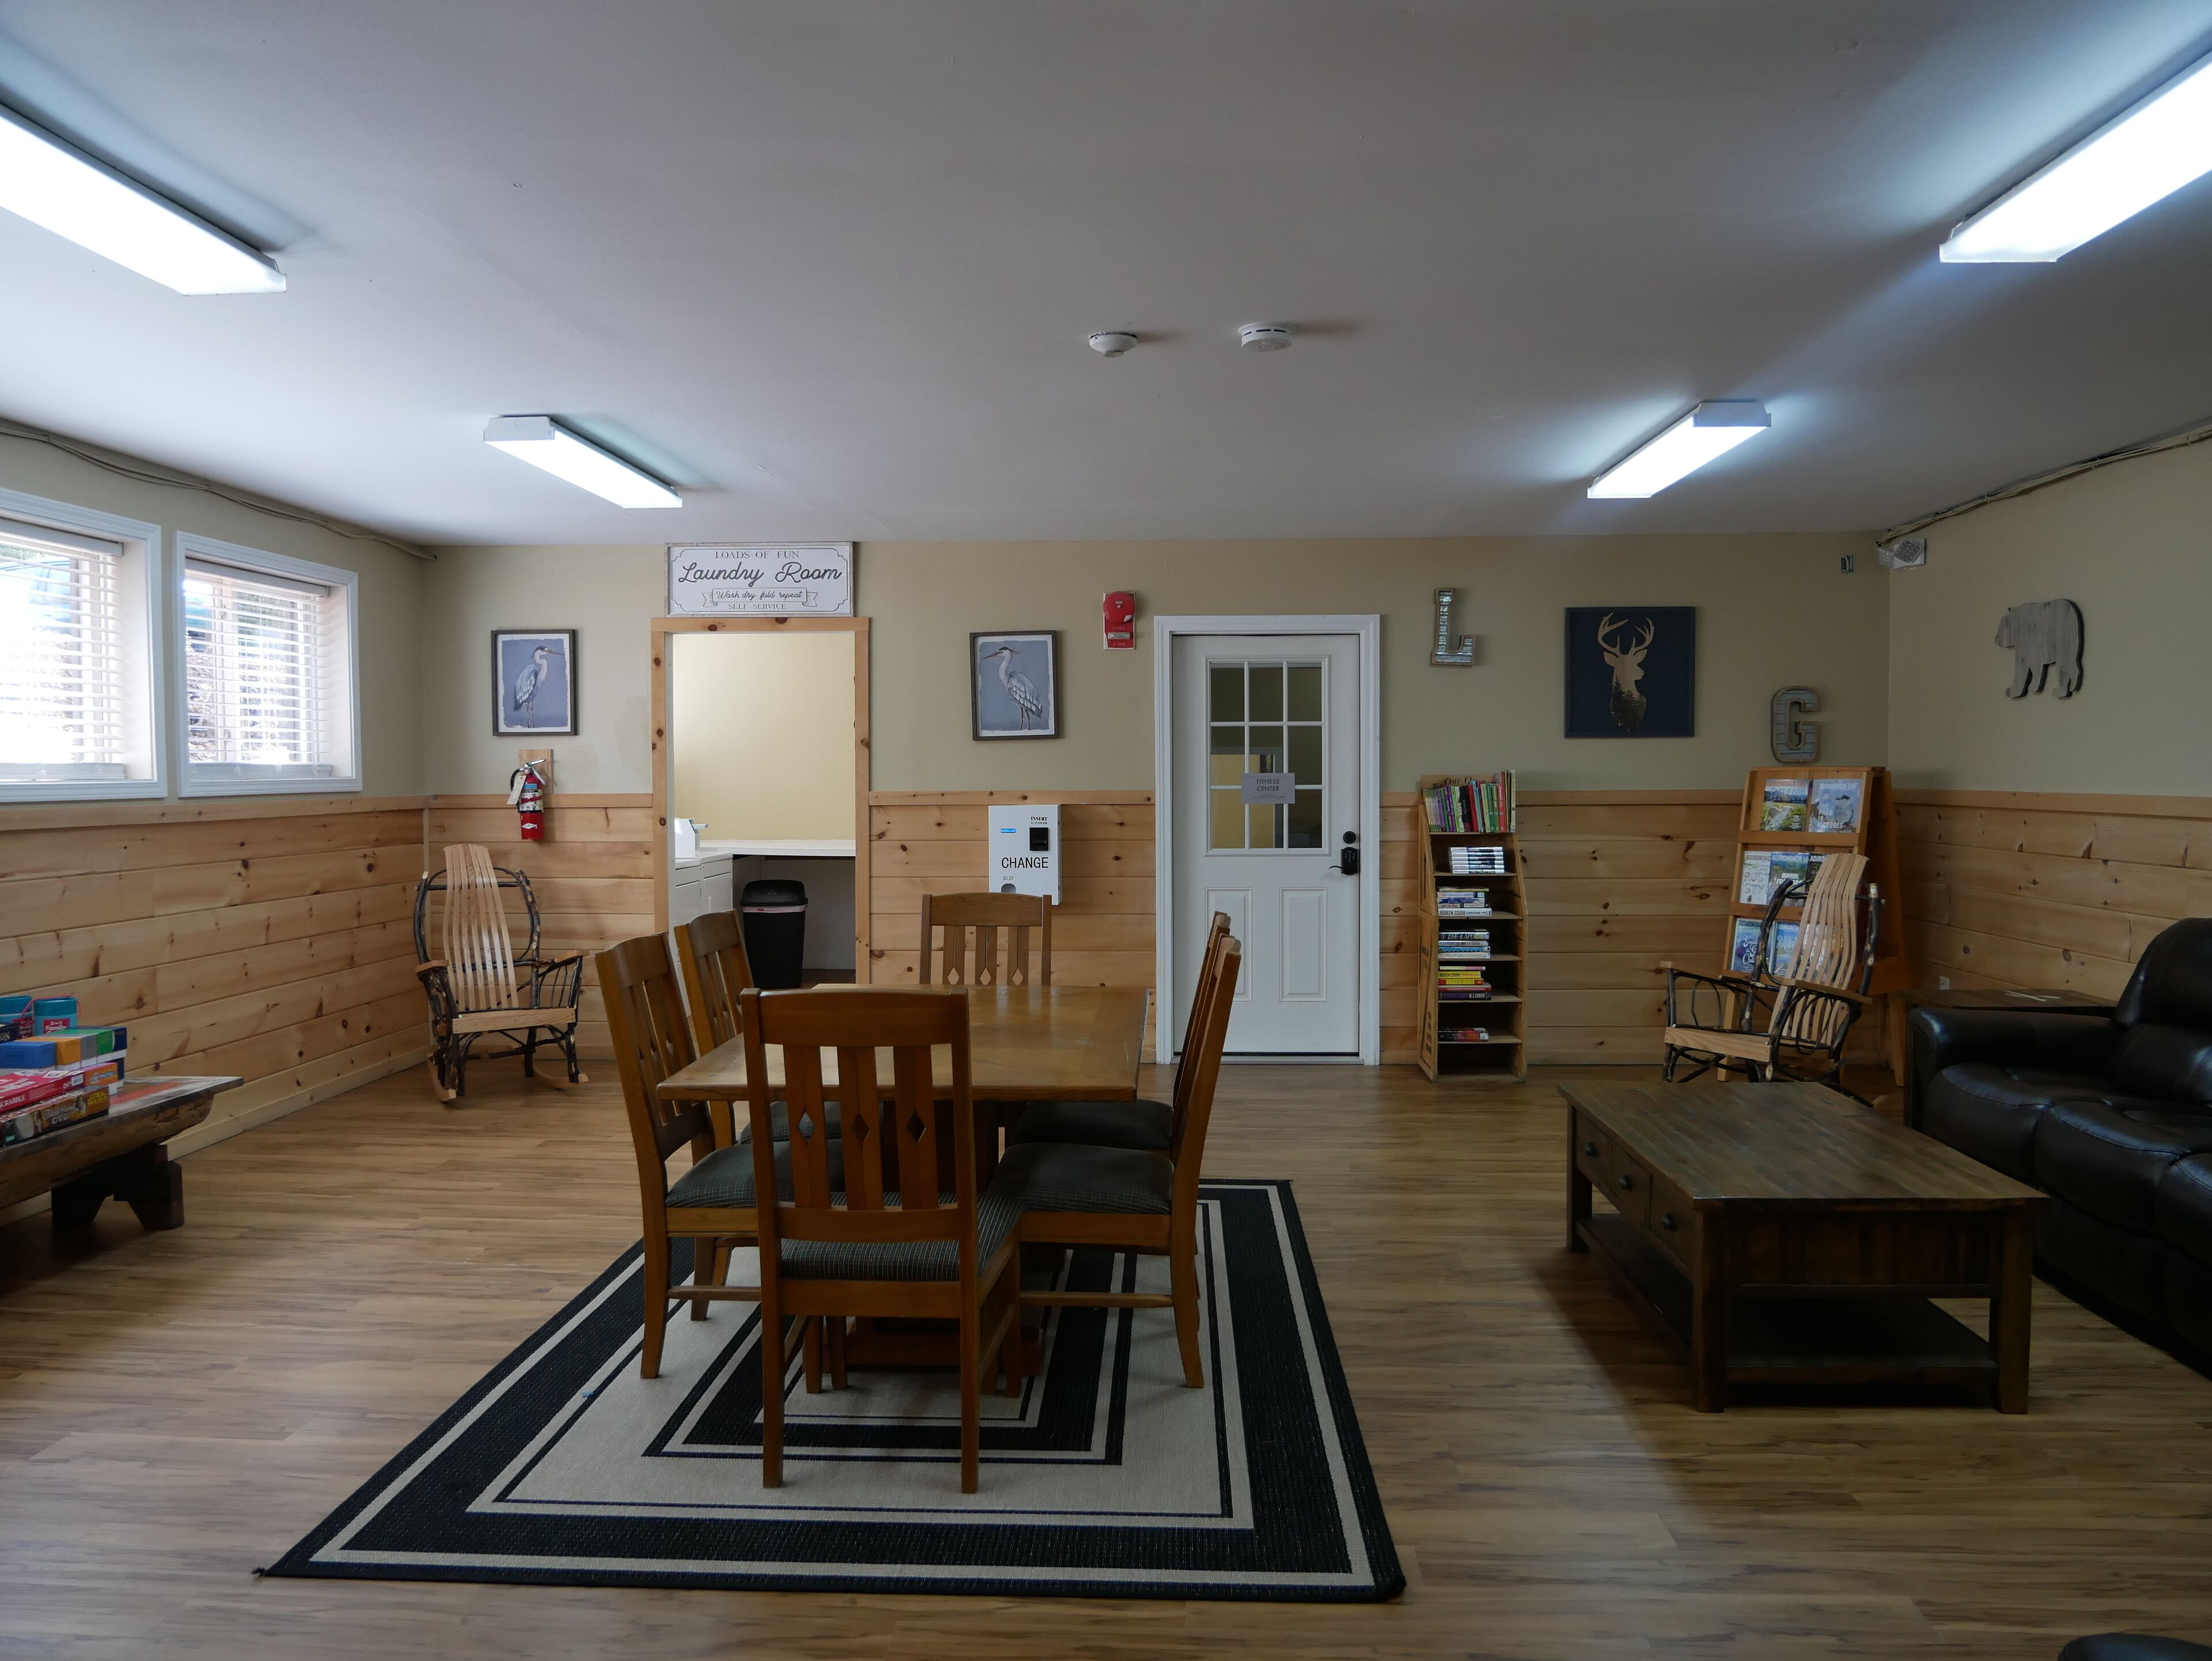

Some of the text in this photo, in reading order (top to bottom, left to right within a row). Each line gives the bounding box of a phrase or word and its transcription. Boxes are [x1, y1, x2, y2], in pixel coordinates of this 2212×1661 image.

[715, 551, 749, 559] LOADS
[755, 551, 770, 559] OF
[678, 561, 842, 588] Laundry Room
[716, 589, 803, 601] Wash dry fold repeat
[1429, 588, 1476, 667] L
[1770, 686, 1819, 763] G
[1001, 857, 1049, 869] CHANGE
